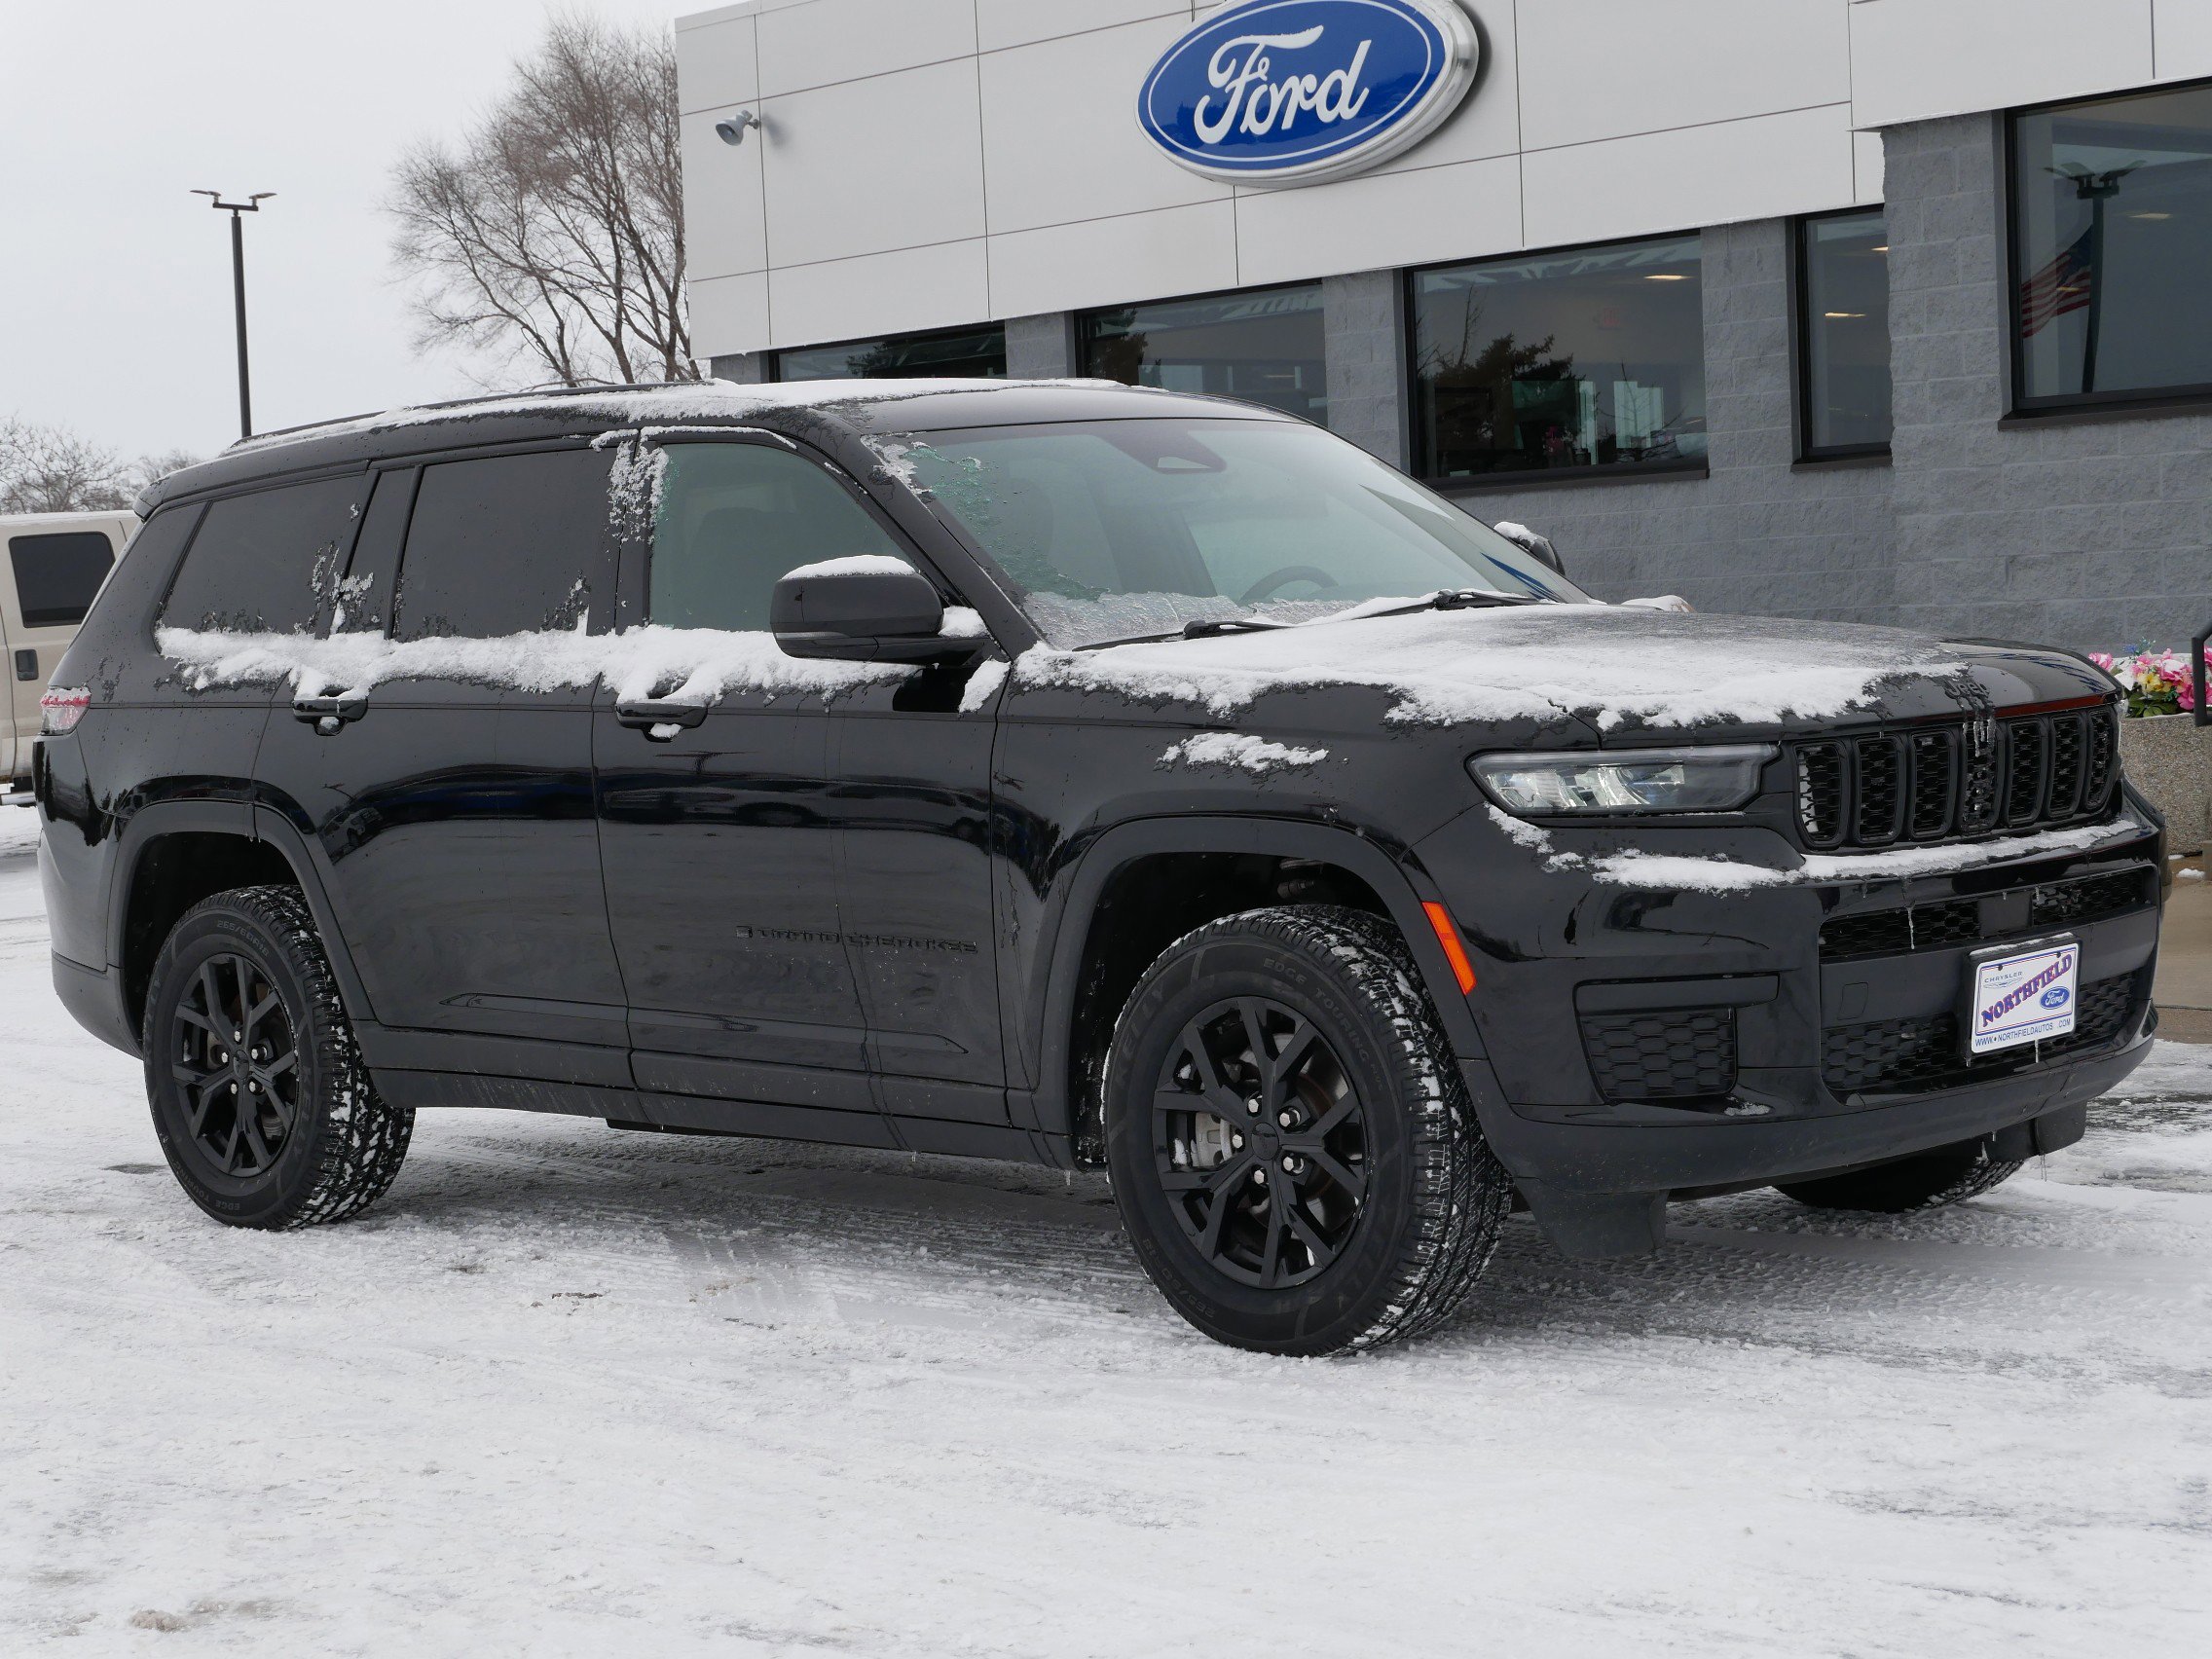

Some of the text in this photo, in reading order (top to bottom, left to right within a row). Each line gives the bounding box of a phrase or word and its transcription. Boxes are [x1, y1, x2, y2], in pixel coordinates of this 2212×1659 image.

[1194, 24, 1372, 144] Ford
[1943, 680, 1989, 699] Jeep
[1981, 954, 2072, 1027] NORTHFIELD
[1984, 972, 2022, 983] CHRYSLER
[2045, 989, 2065, 1005] Ford
[1263, 957, 1370, 1062] EDGE TOURING
